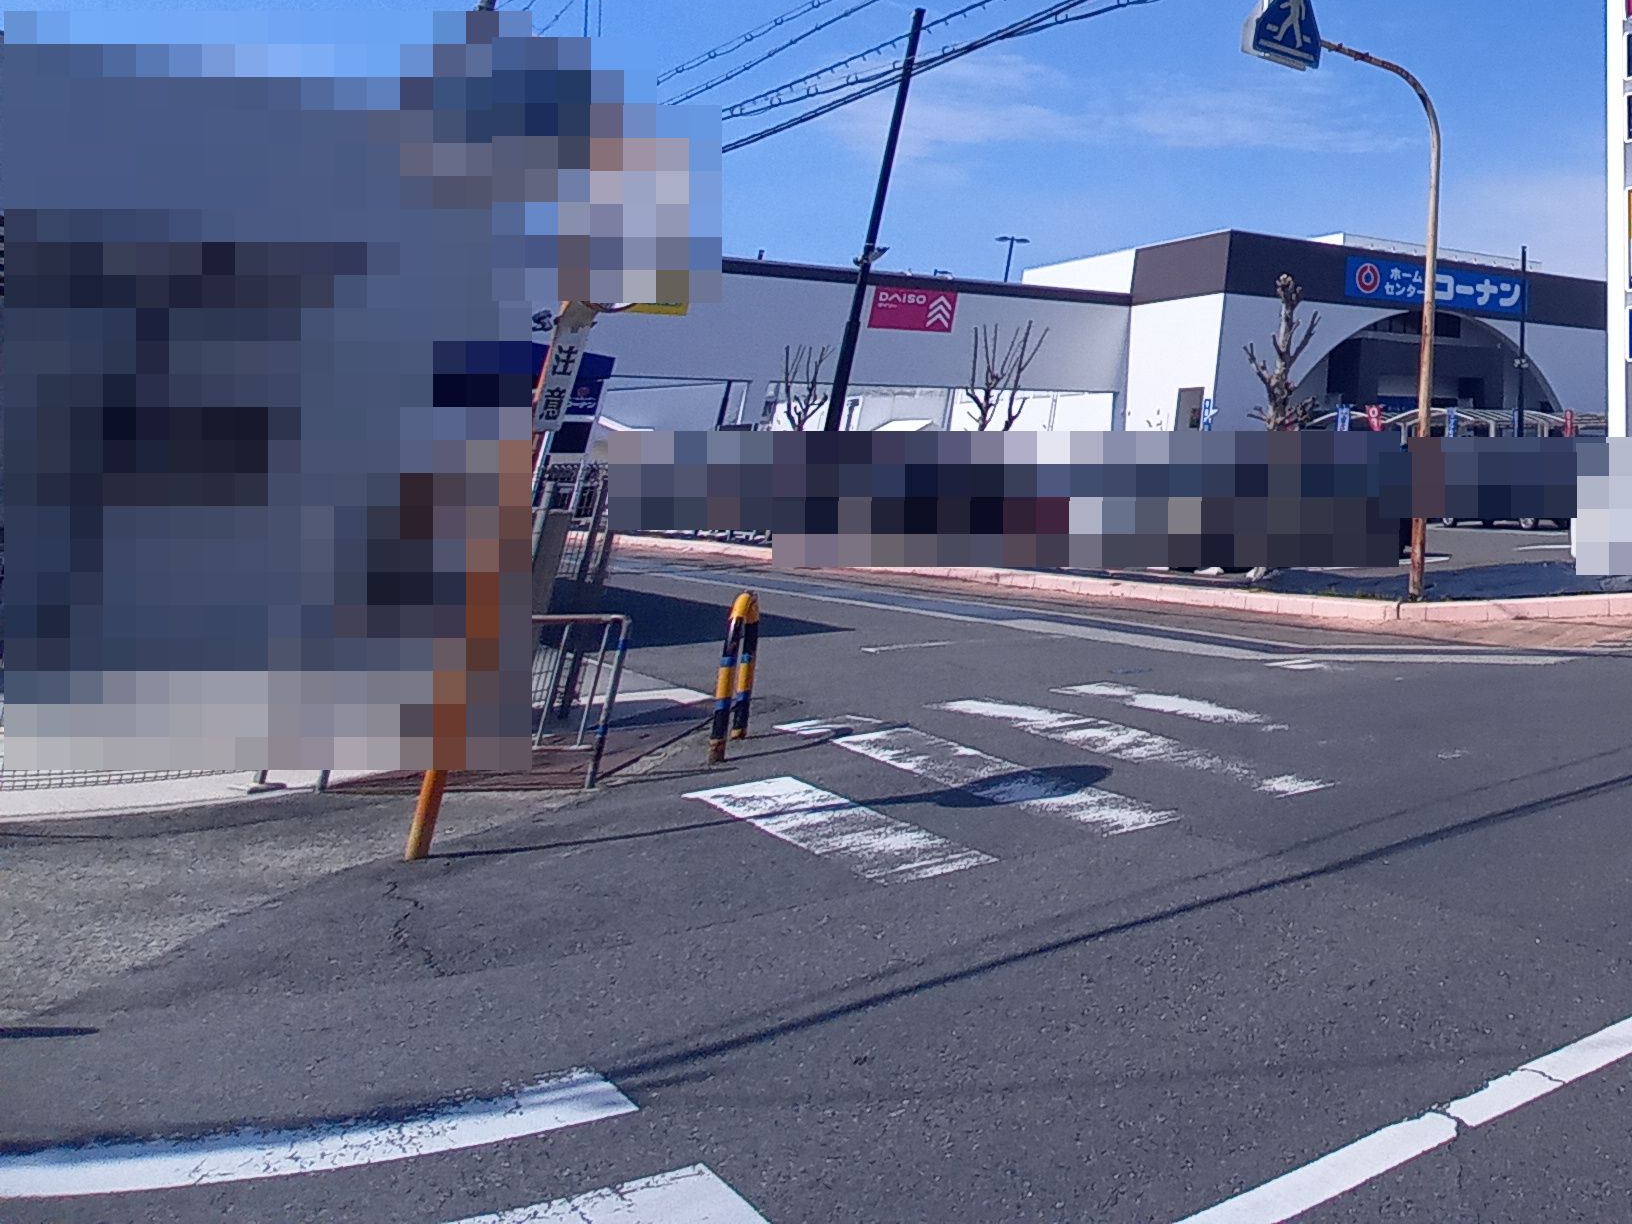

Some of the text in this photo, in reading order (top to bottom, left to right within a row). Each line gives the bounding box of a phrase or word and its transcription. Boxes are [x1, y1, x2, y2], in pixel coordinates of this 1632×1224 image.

[1389, 267, 1423, 283] ホーム
[878, 291, 927, 305] DAISO
[1384, 281, 1426, 298] センター
[1434, 274, 1521, 307] コーナン
[539, 345, 579, 421] 注意
